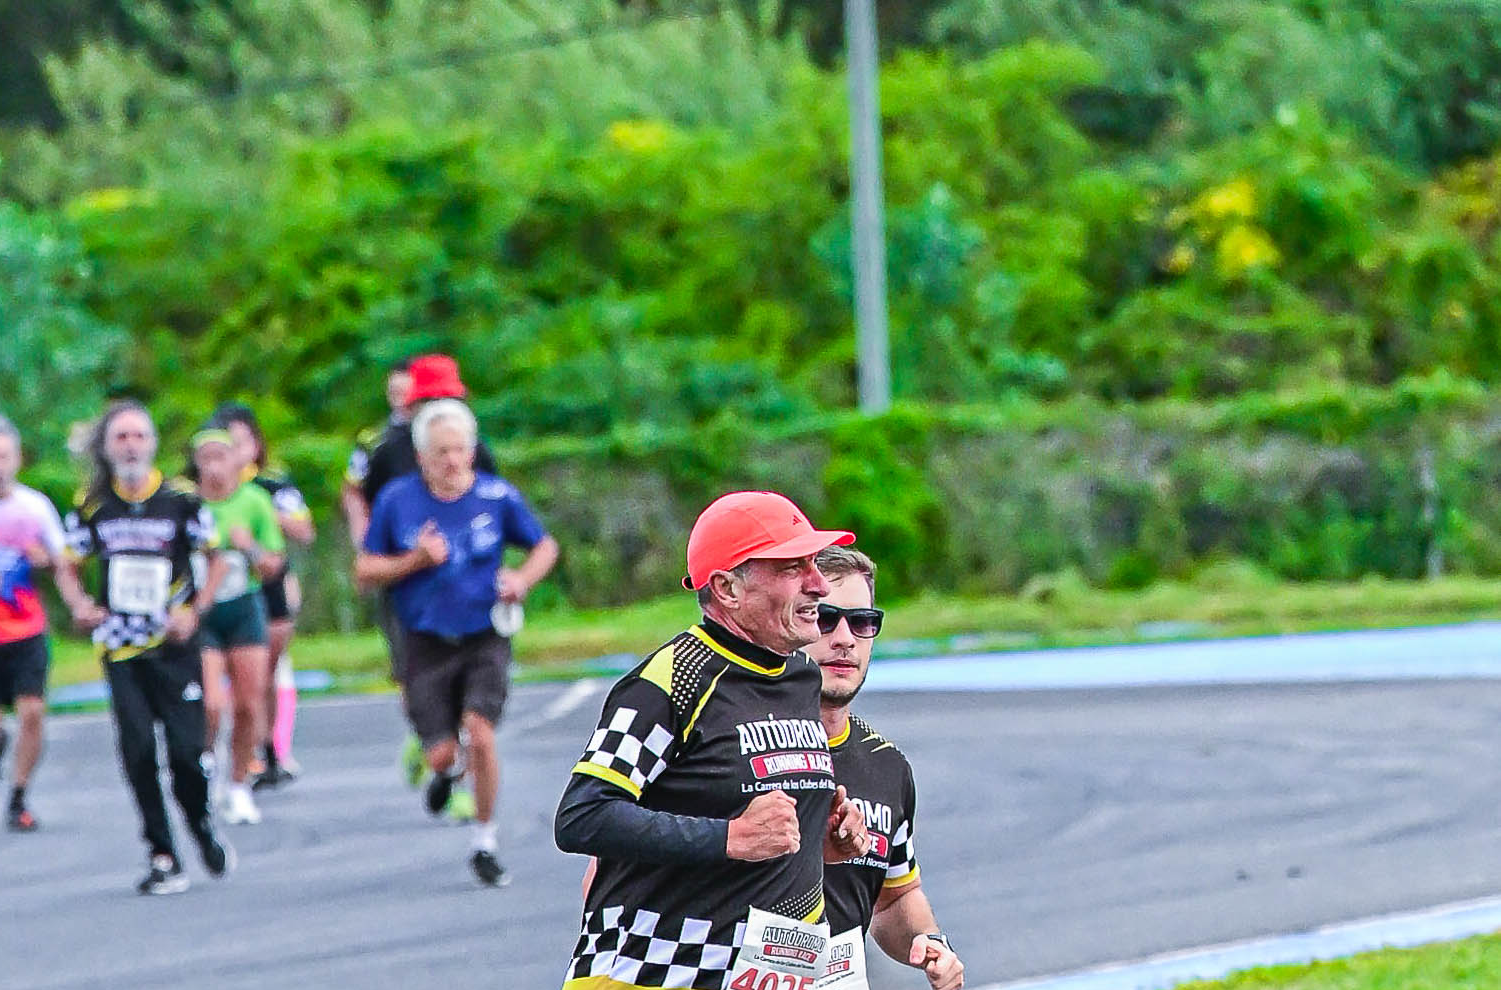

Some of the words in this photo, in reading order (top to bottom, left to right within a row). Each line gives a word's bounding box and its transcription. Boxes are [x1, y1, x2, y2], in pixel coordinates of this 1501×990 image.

[735, 713, 829, 755] AUTÓDROM
[741, 783, 753, 793] La
[754, 782, 782, 792] Carrera
[762, 926, 827, 953] AUTÓDROMO
